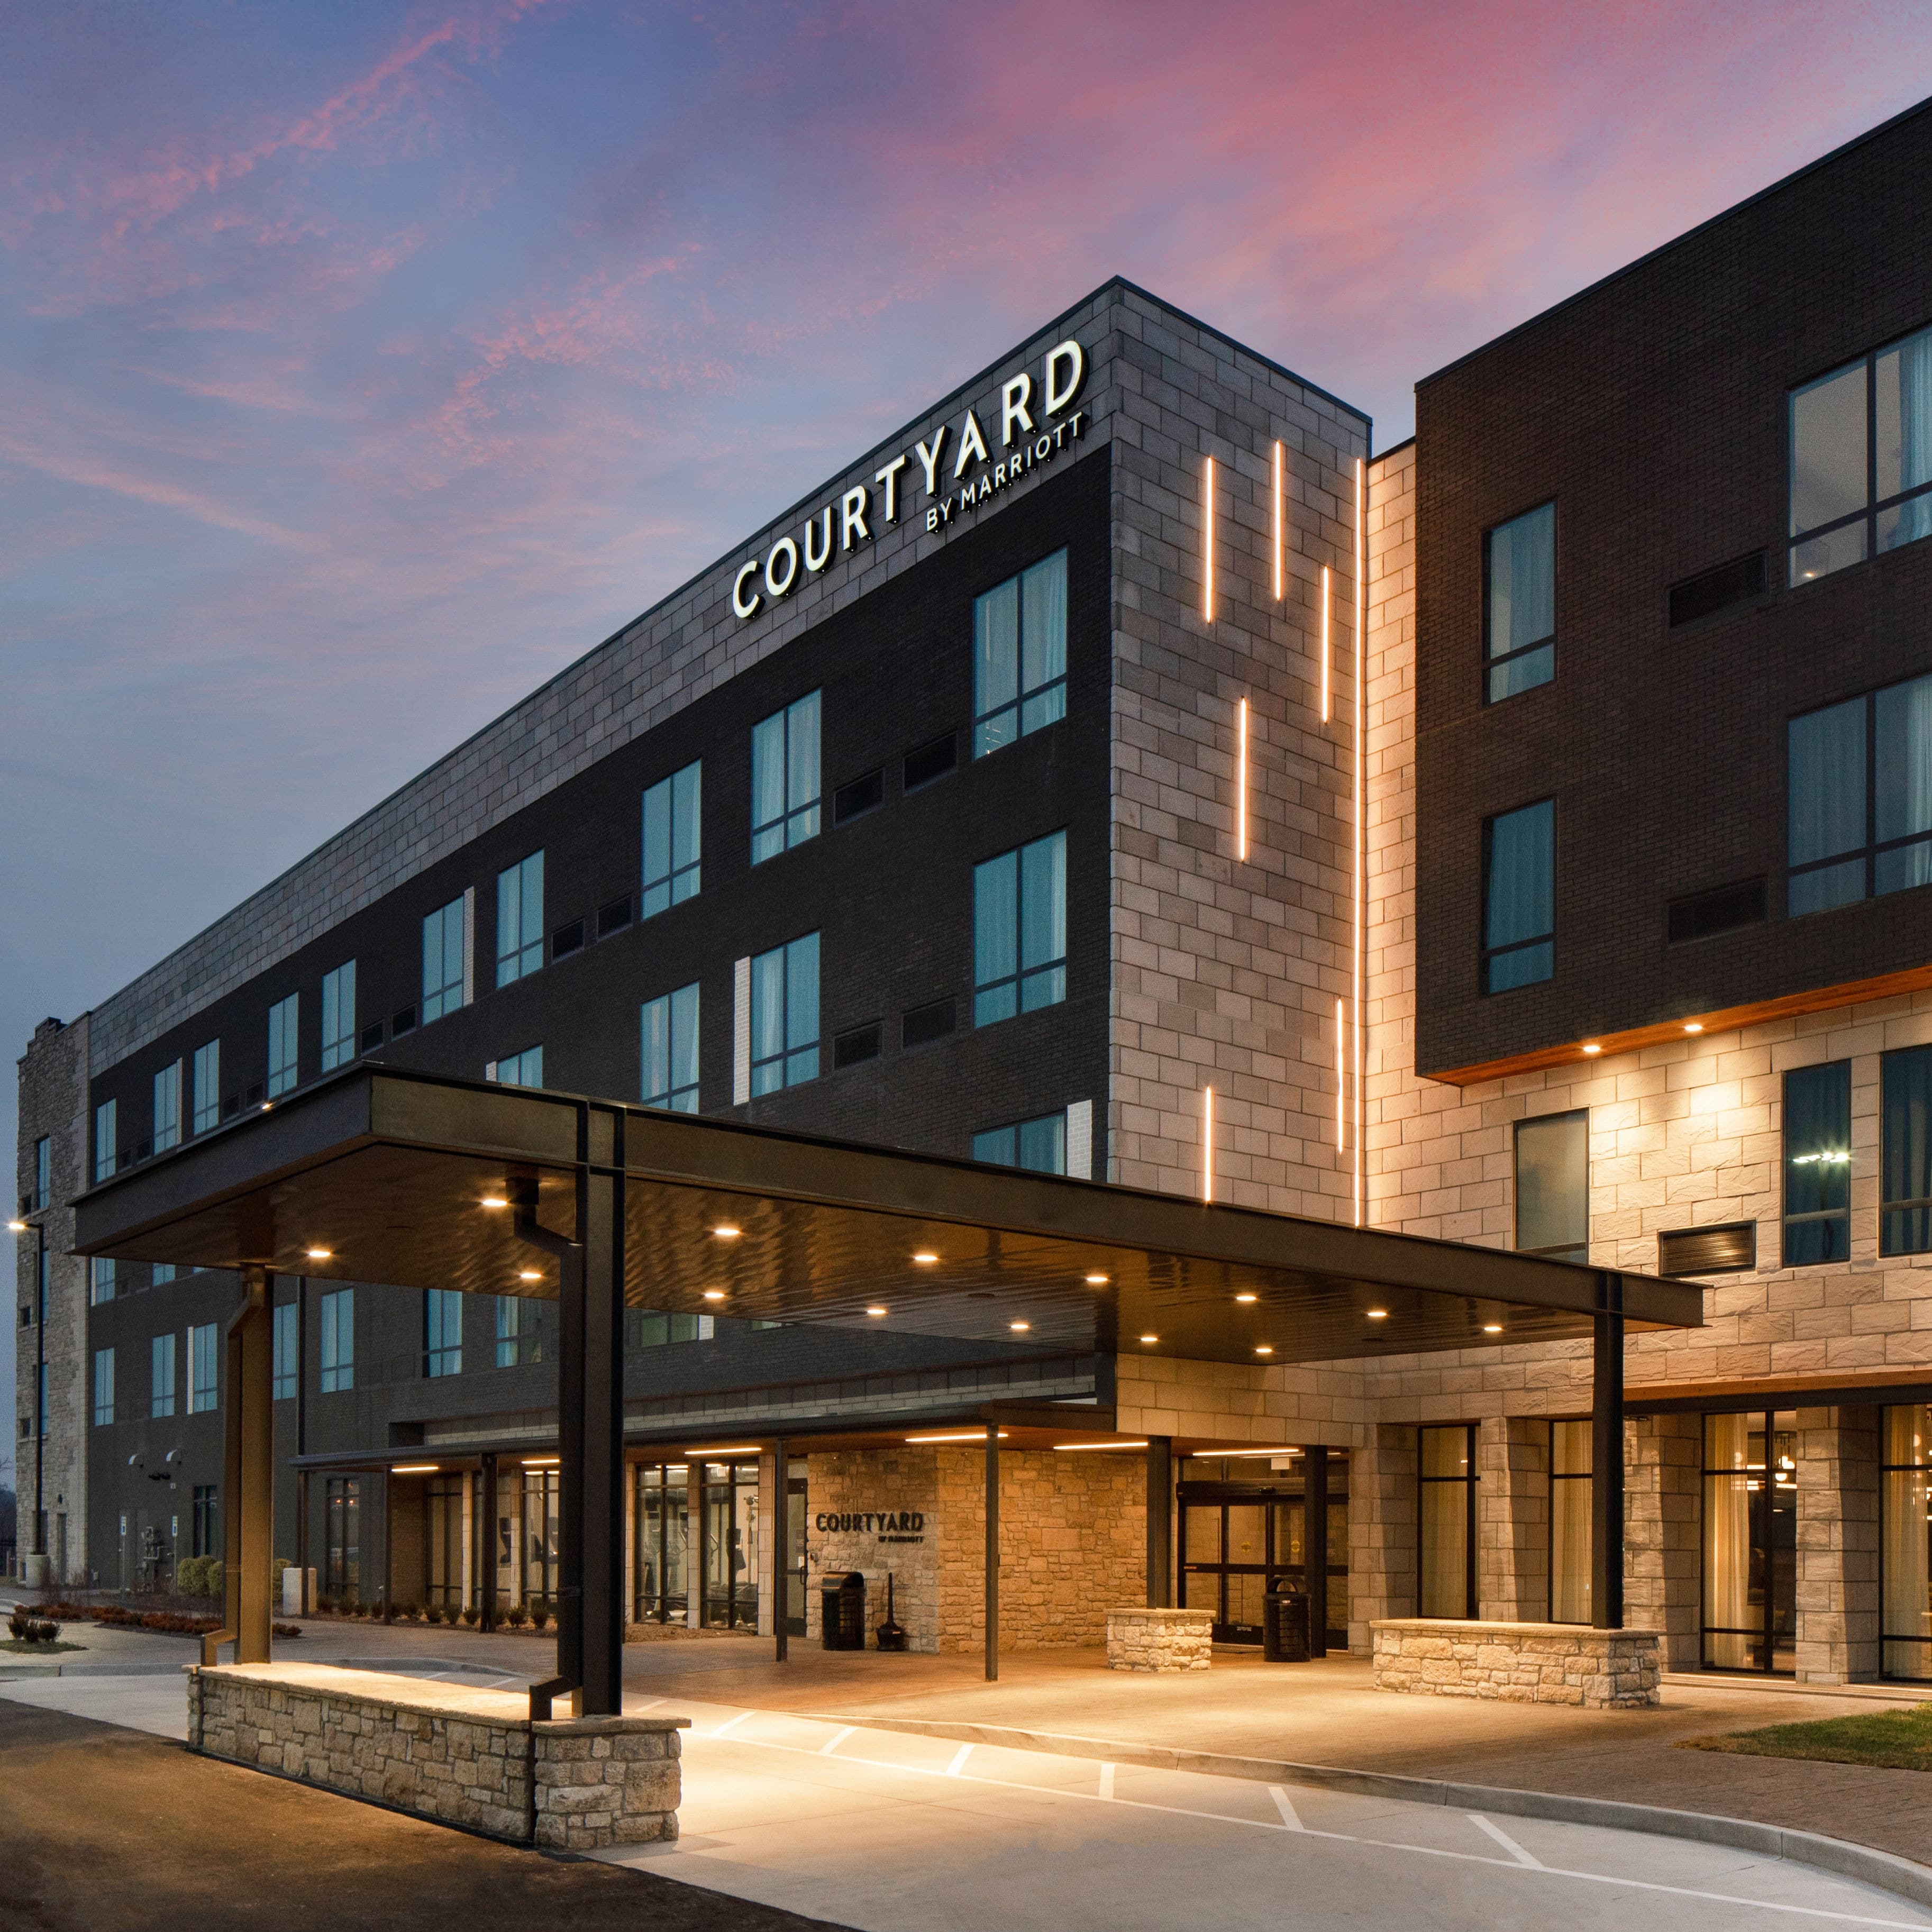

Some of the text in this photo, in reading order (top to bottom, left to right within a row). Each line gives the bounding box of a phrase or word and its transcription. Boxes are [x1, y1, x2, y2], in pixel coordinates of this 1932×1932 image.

[732, 340, 1085, 619] COURTYARD
[926, 411, 1083, 532] BY MARRIOTT
[816, 1512, 924, 1532] COURTYARD
